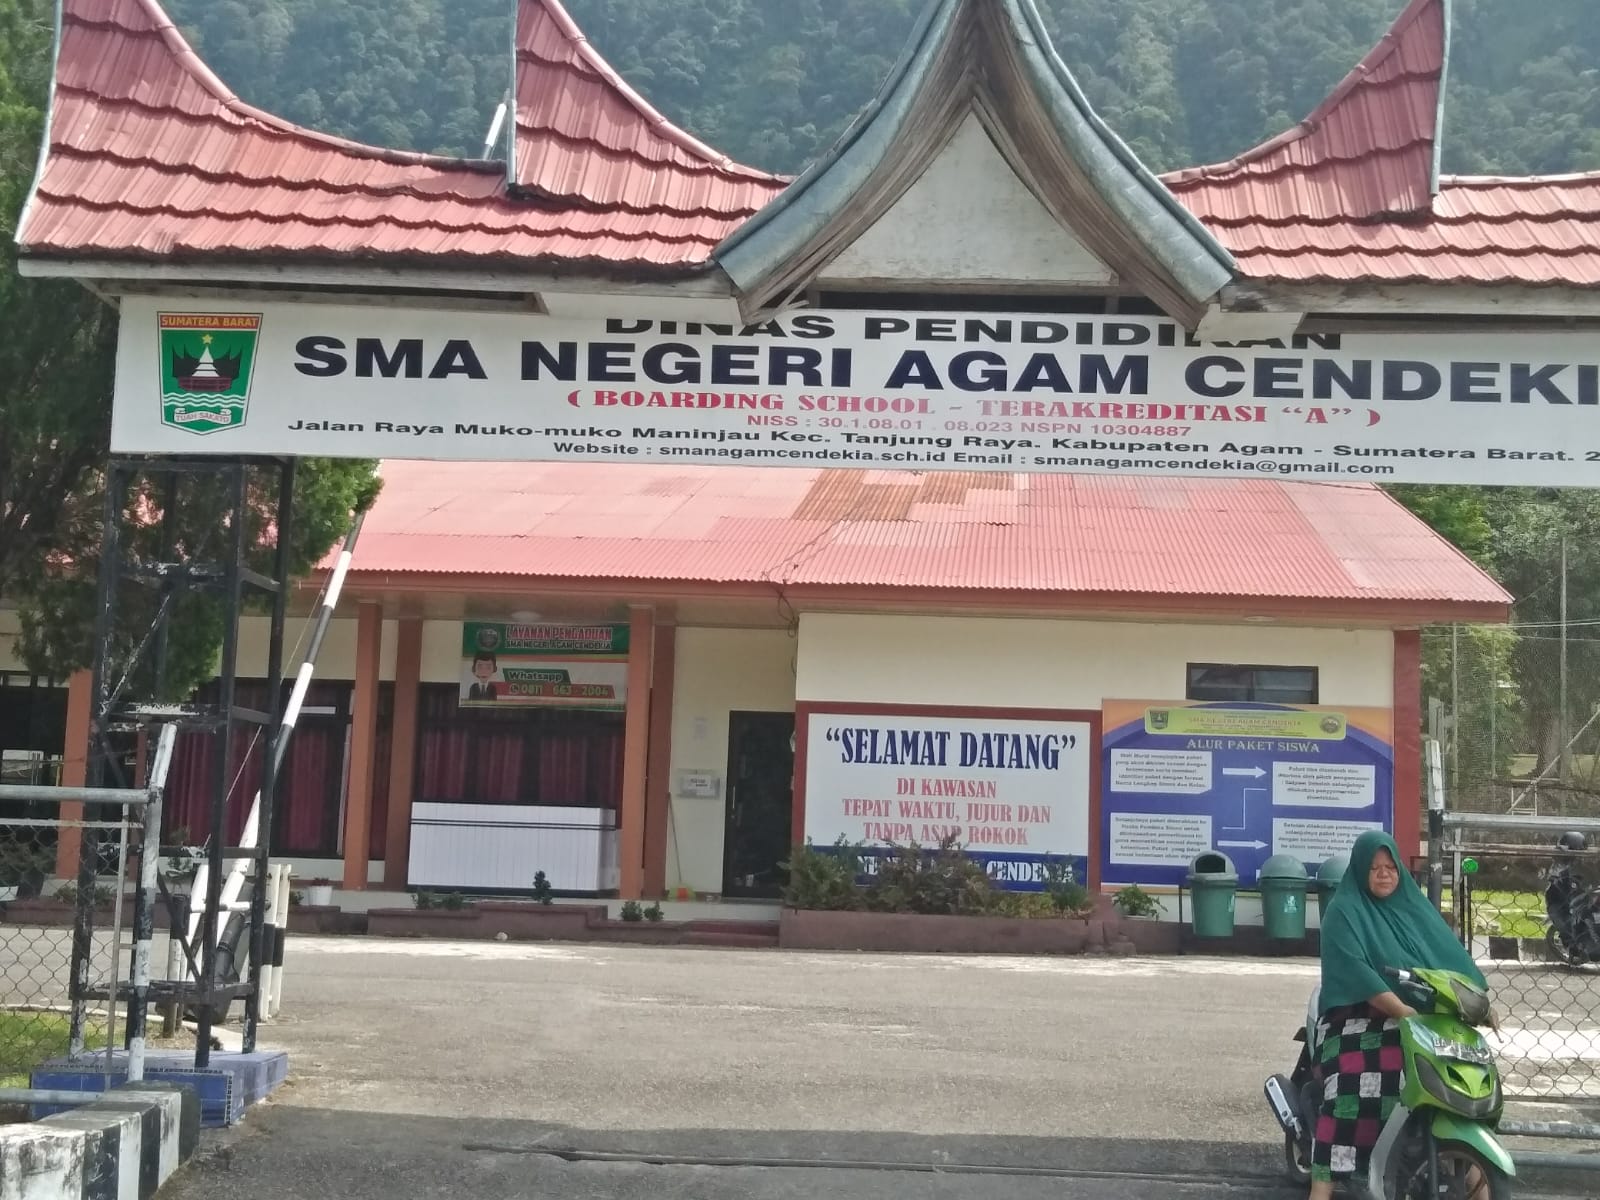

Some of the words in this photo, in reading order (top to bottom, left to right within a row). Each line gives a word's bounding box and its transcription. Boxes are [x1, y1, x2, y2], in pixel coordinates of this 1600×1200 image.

[162, 317, 219, 327] SUMATERA
[222, 318, 258, 327] BARAT
[294, 335, 488, 380] SMA
[520, 340, 852, 389] NEGERI
[884, 349, 1149, 395] AGAM
[1184, 354, 1599, 406] CENDEKI
[593, 390, 785, 411] BOARDING
[798, 394, 936, 415] SCHOOL
[977, 399, 1268, 424] TERAKREDITASI
[747, 415, 798, 427] NISS
[1020, 422, 1082, 434] NSPN
[1090, 424, 1192, 437] 10304887
[287, 419, 364, 433] Jalan
[375, 421, 444, 436] Raya
[454, 423, 623, 438] Muko-muko
[632, 427, 761, 443] Maninjau
[771, 430, 831, 444] Kec.
[840, 432, 952, 449] Tanjung
[963, 435, 1041, 451] Raya.
[1052, 437, 1209, 455] Kabupaten
[1218, 441, 1303, 457] Agam
[1333, 444, 1476, 460] Sumatera
[1487, 448, 1575, 462] Barat.
[553, 442, 639, 455] Website
[659, 444, 945, 464] smanagamcendekia.sch.id
[953, 452, 1013, 465] Email
[1033, 455, 1395, 475] smanagamcendekia@gmail.com
[506, 624, 551, 640] LAYANAN
[552, 626, 613, 642] PENGADUAN
[509, 670, 563, 683] Whatsapp
[1186, 738, 1223, 751] ALUR
[1227, 740, 1274, 752] PAKET
[1277, 741, 1321, 754] SISWA
[896, 777, 915, 796] DI
[921, 778, 997, 799] KAWASAN
[842, 798, 893, 818] TEPAT
[899, 800, 960, 820] WAKTU,
[966, 803, 1012, 823] JUJUR
[1017, 805, 1052, 824] DAN
[863, 821, 914, 841] TANPA
[968, 826, 1029, 846] ROKOK
